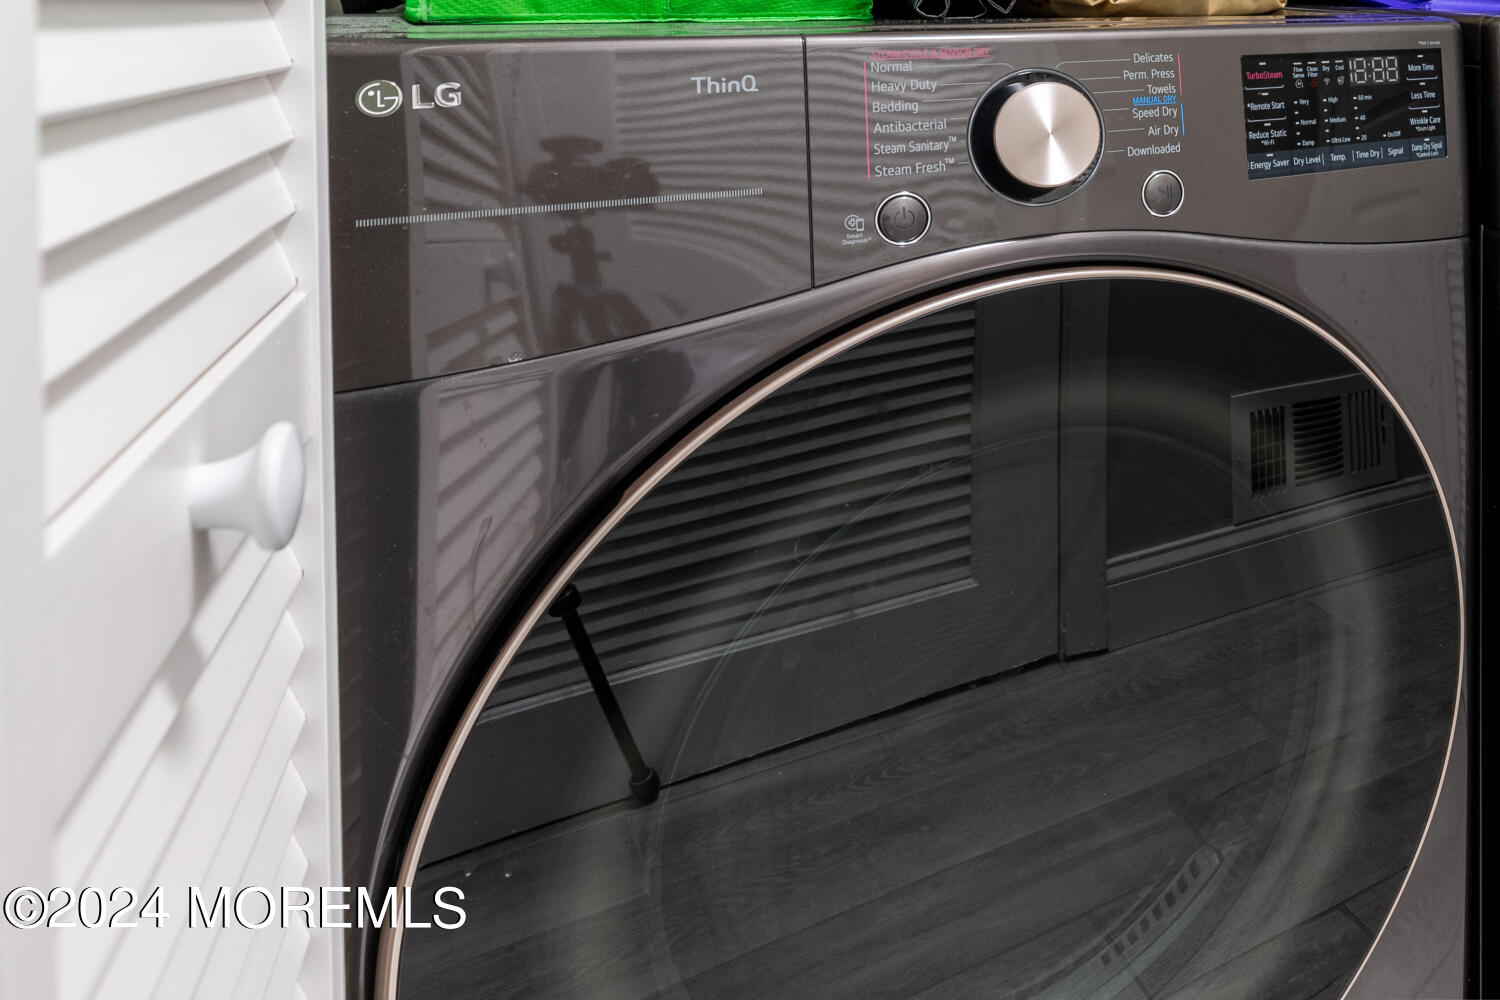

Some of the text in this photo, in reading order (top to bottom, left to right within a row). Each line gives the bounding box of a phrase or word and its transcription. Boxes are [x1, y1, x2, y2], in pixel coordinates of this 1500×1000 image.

[1133, 52, 1174, 64] Delicates
[870, 61, 912, 73] Normal
[1408, 63, 1434, 72] More Time
[1122, 68, 1175, 80] Perm. Press
[1246, 72, 1283, 80] TurboSteam
[691, 74, 759, 96] ThinQ
[871, 80, 938, 94] Heavy Duty
[1146, 84, 1176, 94] Towels
[412, 82, 462, 110] LG
[1132, 96, 1176, 105] MANUAL DRY
[1328, 96, 1338, 104] High
[1411, 90, 1436, 100] Less Time
[872, 100, 919, 114] Bedding
[1271, 101, 1285, 109] Start
[1299, 98, 1310, 106] Very
[1132, 106, 1178, 119] Speed Dry
[874, 118, 948, 134] Antibacterial
[1329, 116, 1347, 124] Medium
[1410, 116, 1441, 126] Wrinkle Care
[1148, 124, 1180, 136] Air Dry
[1248, 128, 1288, 140] Reduce Static
[1387, 130, 1401, 138] On/Off
[874, 142, 906, 156] Steam
[1127, 143, 1181, 157] Downloaded
[1388, 146, 1404, 156] Signal
[1412, 144, 1424, 152] Damp
[1430, 141, 1442, 150] Signal
[1330, 153, 1346, 163] Temp.
[1356, 150, 1380, 158] Time Dry
[1250, 158, 1290, 170] Energy Saver
[1293, 155, 1321, 167] Dry Level
[874, 163, 912, 178] Steam
